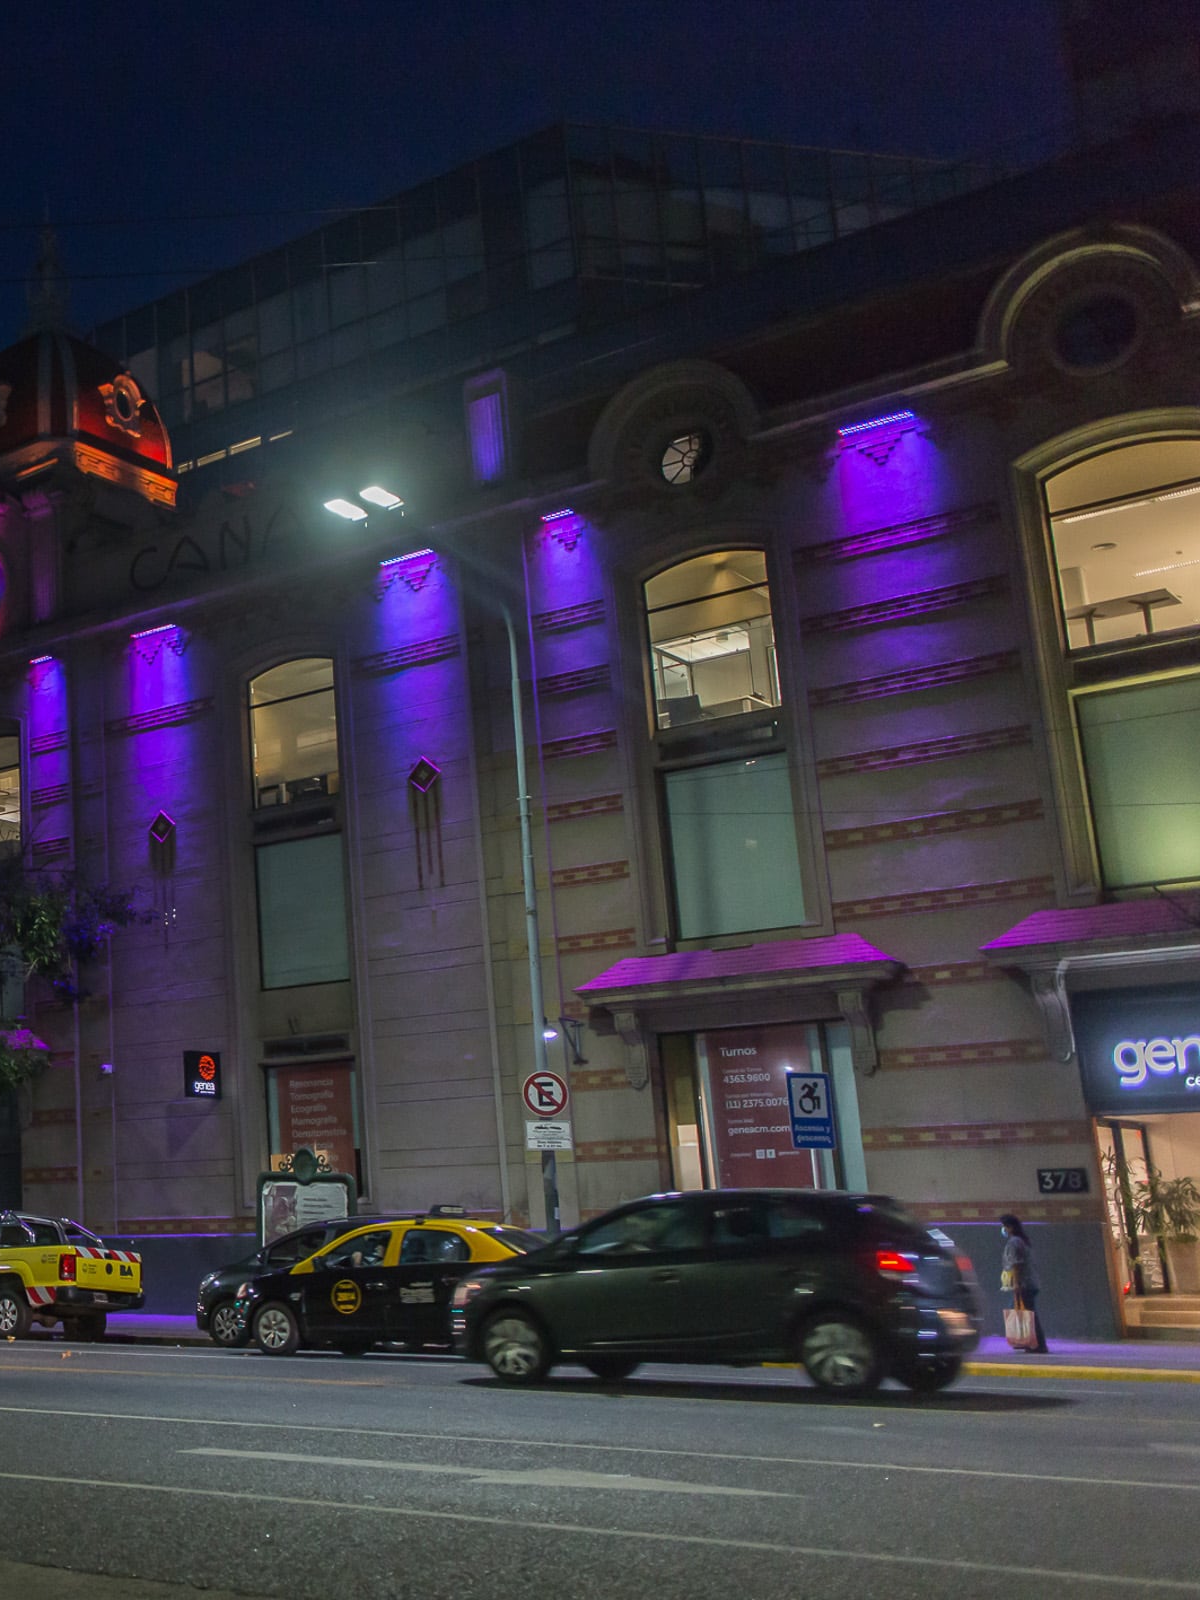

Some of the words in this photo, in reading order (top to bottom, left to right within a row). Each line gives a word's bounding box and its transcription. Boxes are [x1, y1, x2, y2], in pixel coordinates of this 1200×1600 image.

[720, 1047, 757, 1057] Turnos
[194, 1081, 216, 1093] genea
[1040, 1171, 1082, 1190] 378
[119, 1265, 133, 1277] BA
